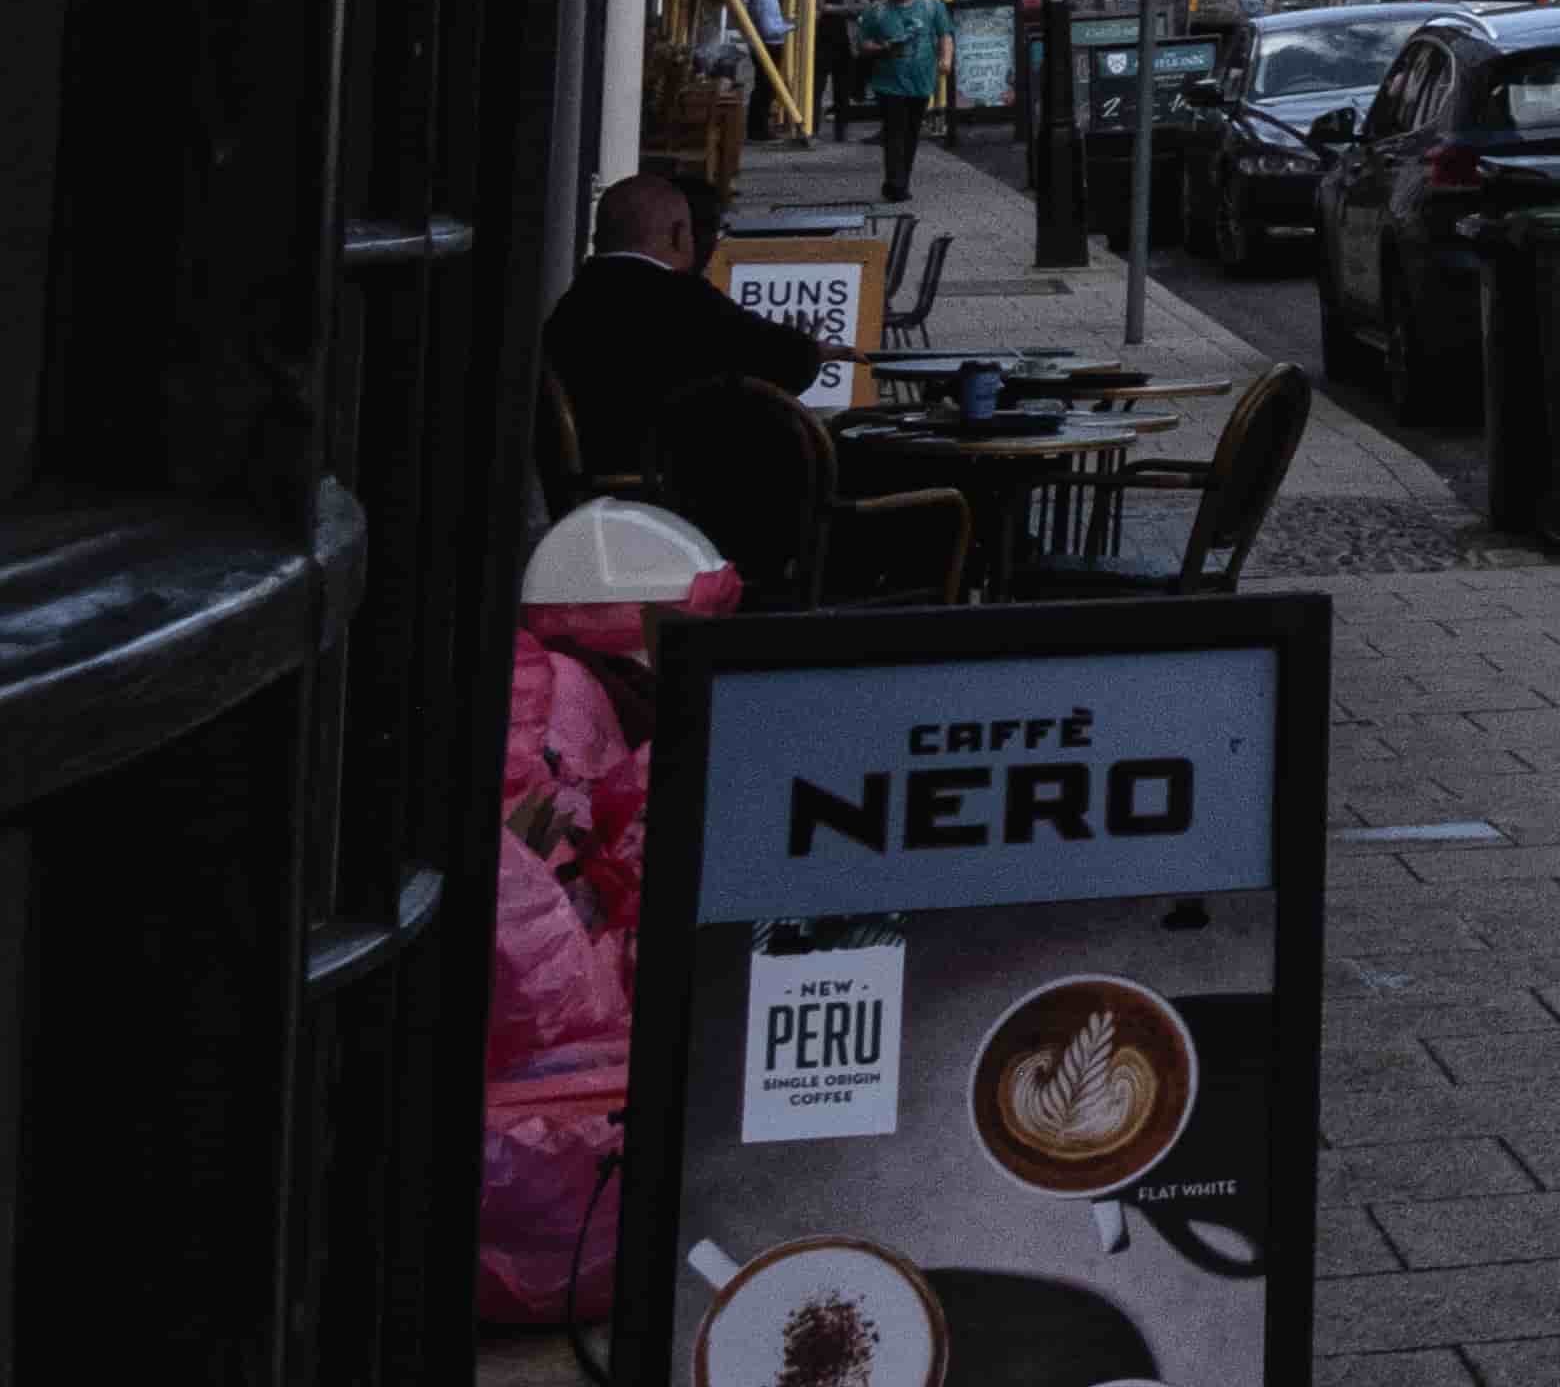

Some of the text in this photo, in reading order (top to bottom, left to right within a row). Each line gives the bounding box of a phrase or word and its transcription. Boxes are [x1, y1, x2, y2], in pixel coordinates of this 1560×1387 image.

[741, 279, 848, 306] BUNS
[908, 706, 1094, 755] CAFFÈ
[787, 756, 1195, 858] NERO
[800, 979, 854, 998] NEW
[765, 1000, 883, 1071] PERU
[763, 1073, 881, 1091] SINGLE ORIGIN
[789, 1091, 854, 1107] COFFEE
[1138, 1179, 1237, 1202] FLAT WHITE
